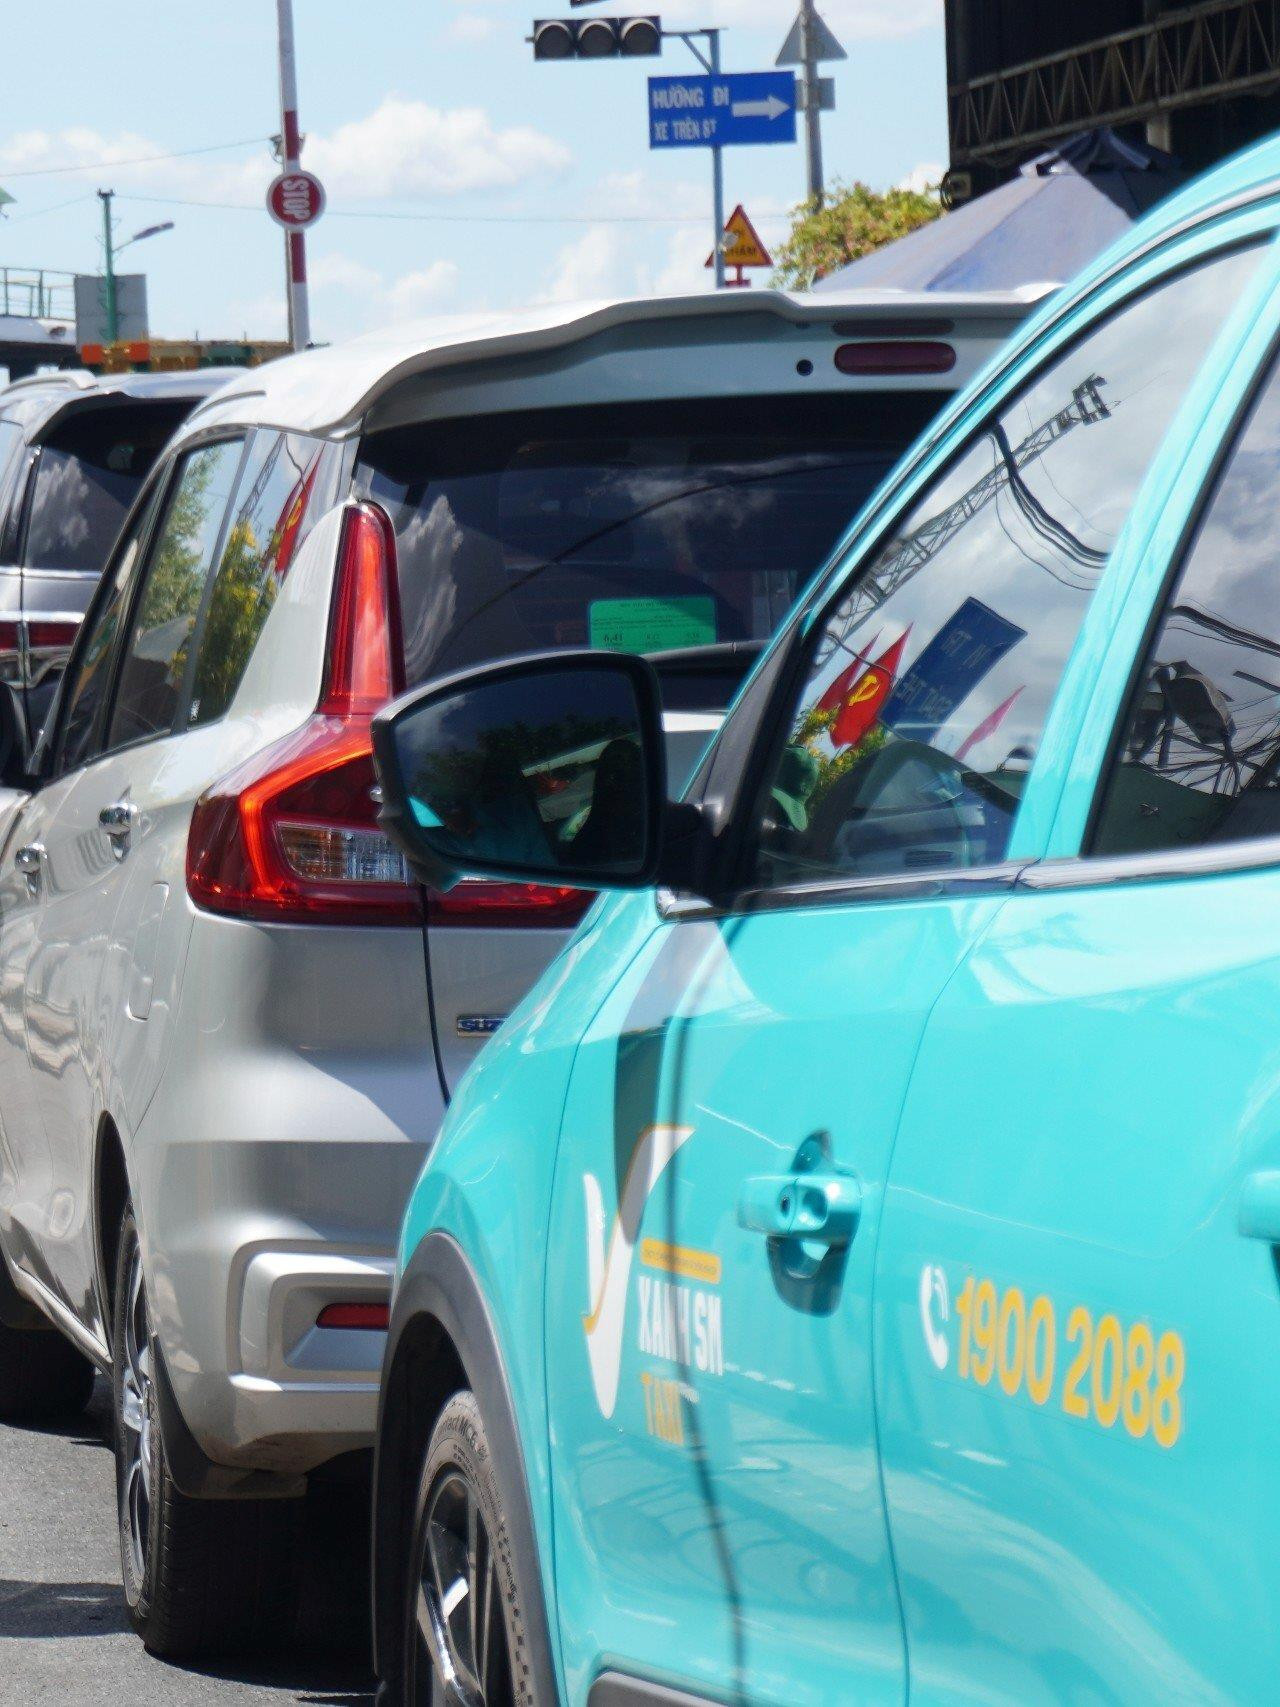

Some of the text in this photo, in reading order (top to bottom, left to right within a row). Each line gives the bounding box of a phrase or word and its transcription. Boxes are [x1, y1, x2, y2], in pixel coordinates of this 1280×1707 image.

[638, 1275, 723, 1377] XANH SM
[956, 1276, 1185, 1449] 1900 2088
